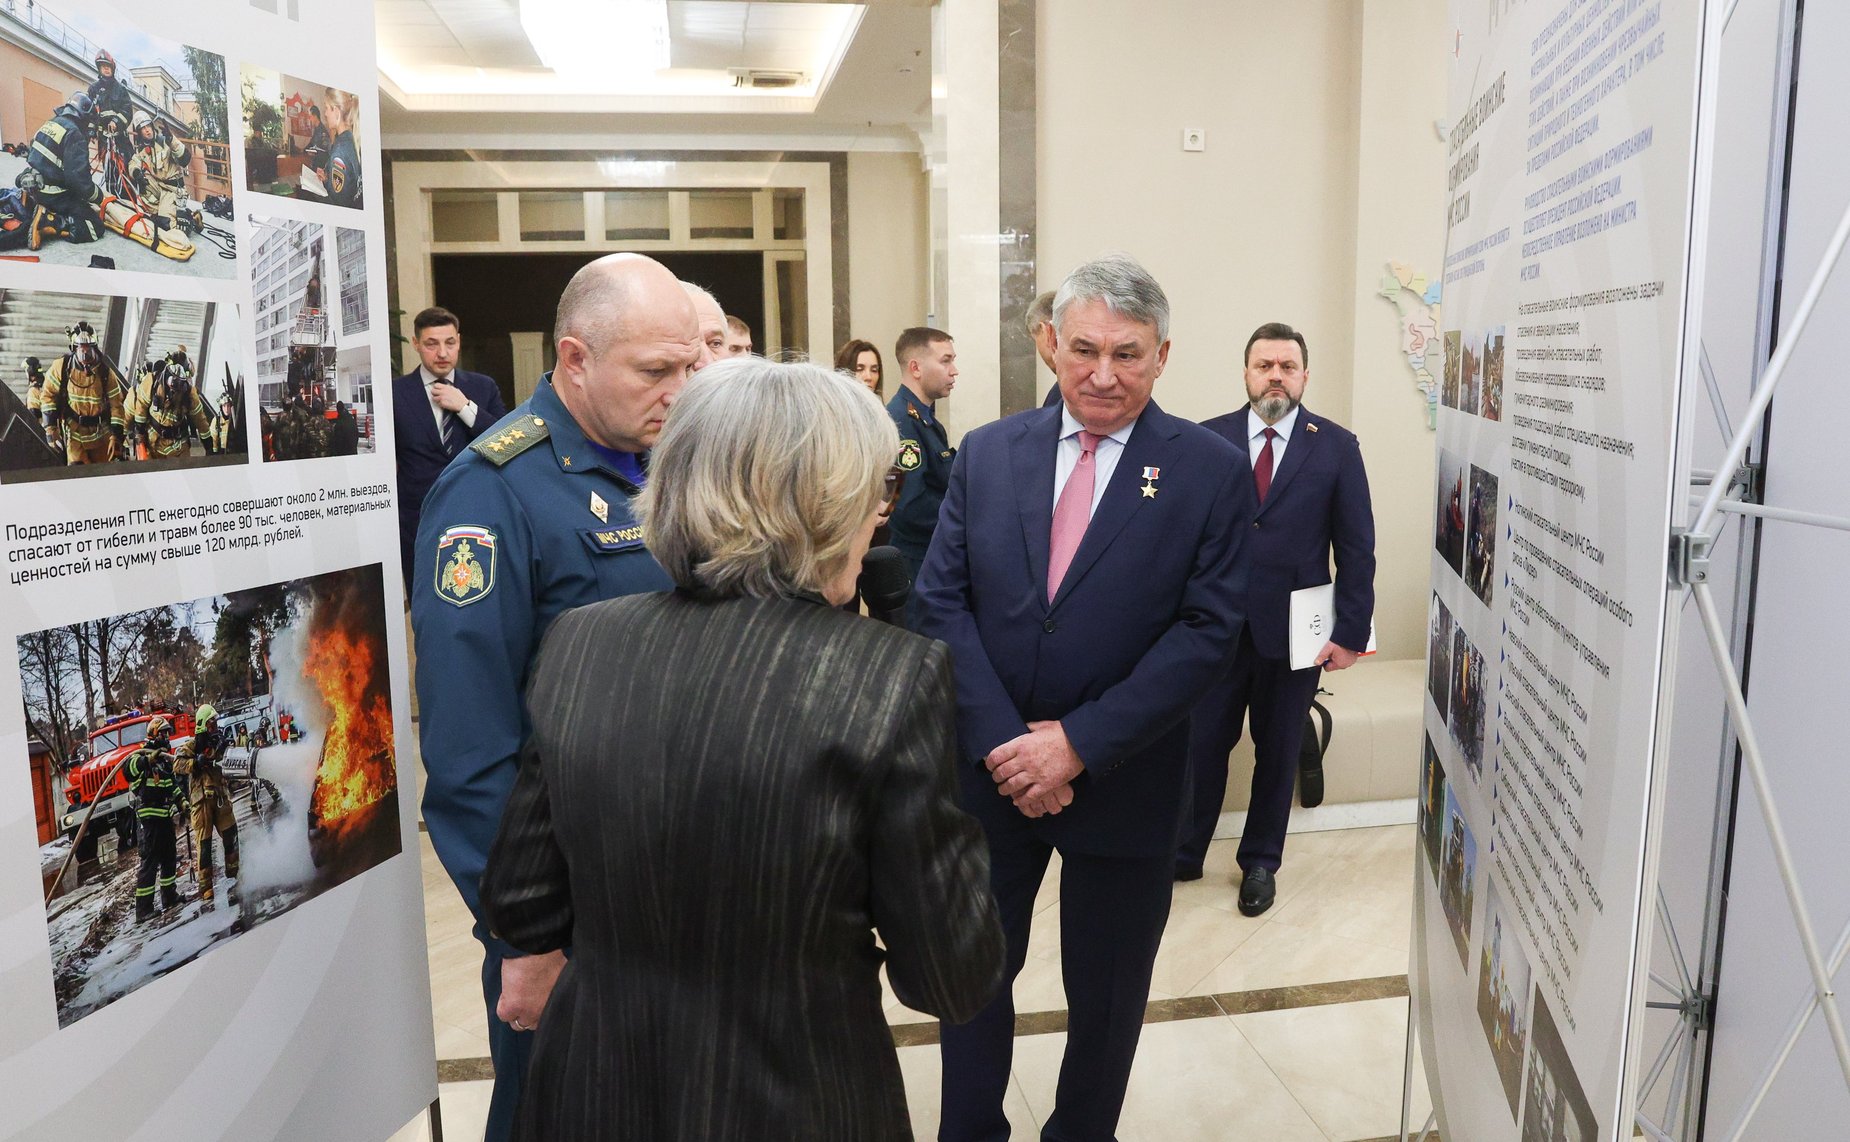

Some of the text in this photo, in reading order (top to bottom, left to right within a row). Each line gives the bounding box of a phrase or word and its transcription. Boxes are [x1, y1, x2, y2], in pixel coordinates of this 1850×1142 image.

[6, 483, 390, 541] Подразделения ГПС ежегодно совершают около 2 млн. выездов,
[8, 499, 391, 562] спасают от гибели и травм более 90 тыс. человек, материальных
[596, 526, 644, 544] МЧС РОССИ
[10, 526, 304, 586] ценностей на сумму свыше 120 млрд. рублей.
